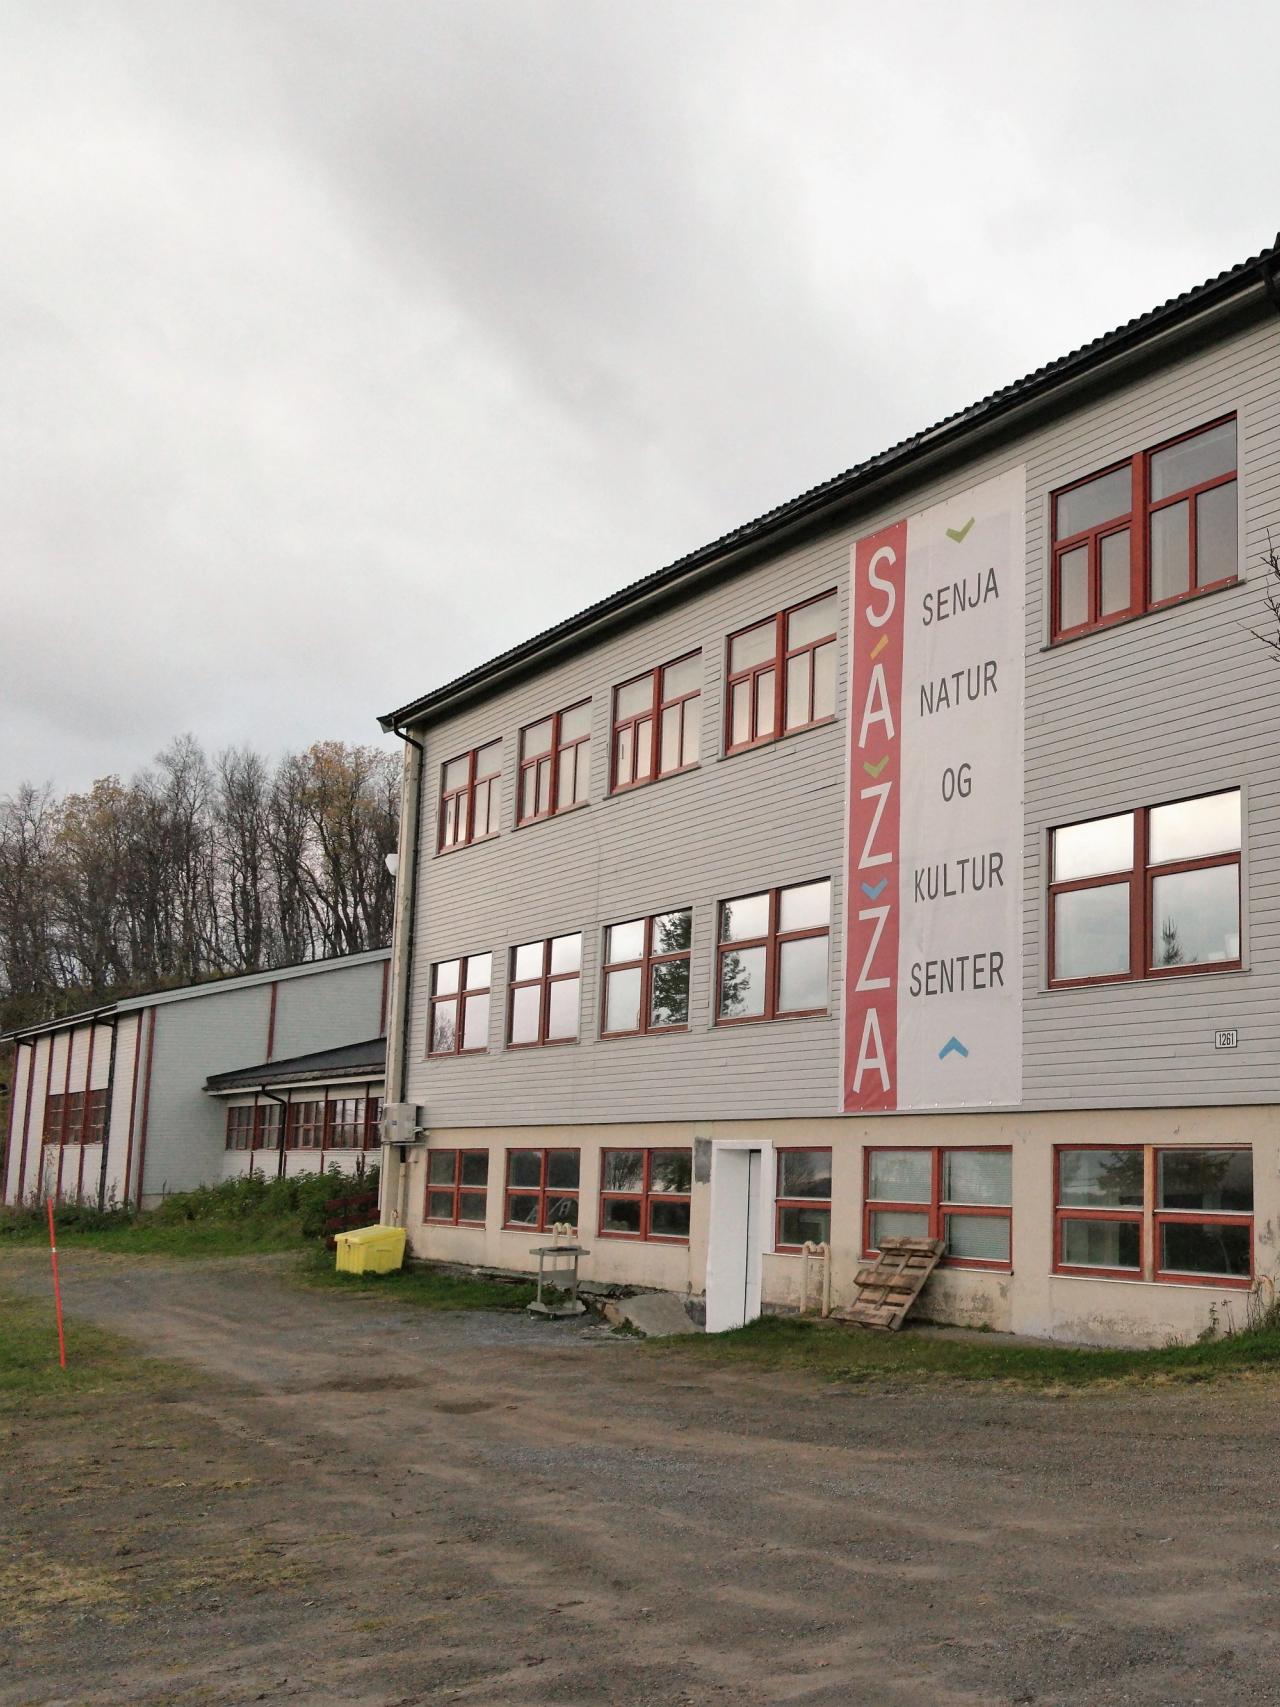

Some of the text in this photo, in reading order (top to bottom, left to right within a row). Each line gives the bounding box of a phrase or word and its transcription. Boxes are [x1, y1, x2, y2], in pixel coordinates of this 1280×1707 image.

[922, 567, 999, 626] SENJA
[920, 660, 998, 717] NATUR
[941, 762, 972, 802] OG
[914, 852, 1004, 903] KULTUR
[909, 951, 1004, 997] SENTER
[1219, 1032, 1234, 1046] 1261
